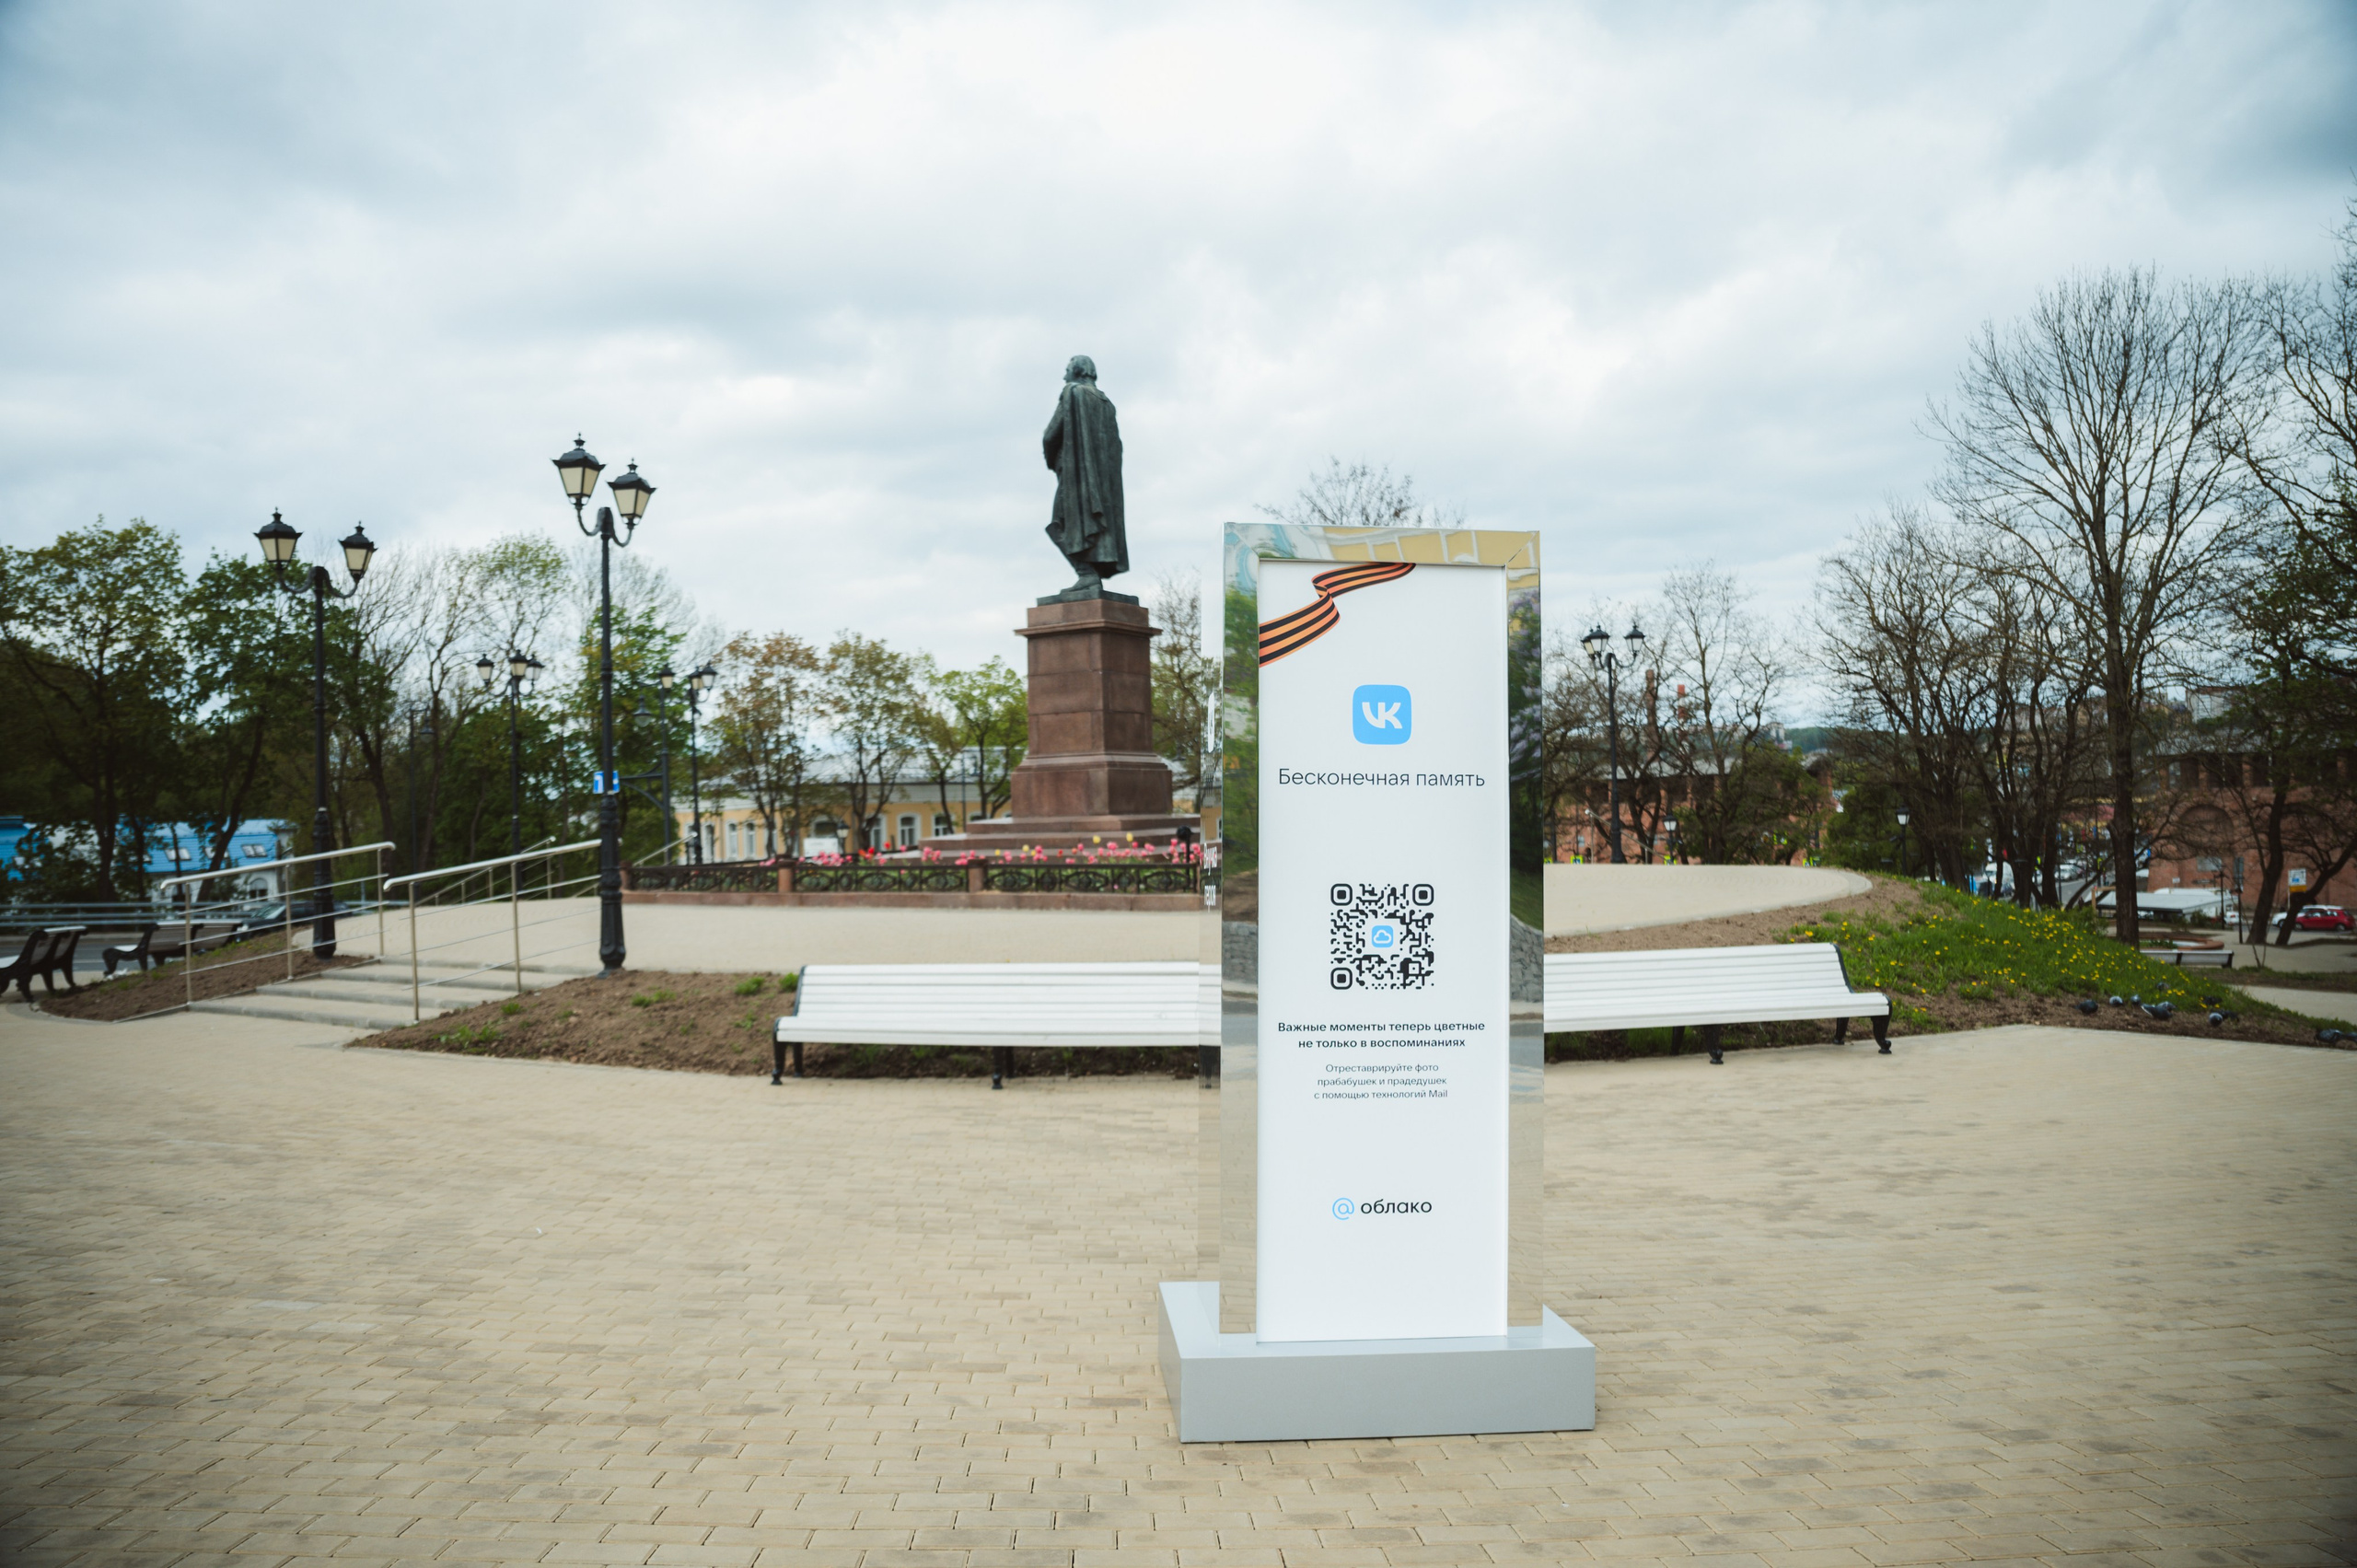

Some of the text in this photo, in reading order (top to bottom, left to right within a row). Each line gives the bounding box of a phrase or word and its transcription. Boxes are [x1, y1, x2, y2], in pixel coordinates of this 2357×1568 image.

[1362, 702, 1403, 729] VK
[1278, 768, 1486, 786] Бесконечная память
[1278, 1022, 1486, 1034] Важные моменты теперь цветные
[1298, 1040, 1466, 1049] не только в воспоминаниях
[1325, 1063, 1439, 1074] Отреставрируйте фото
[1317, 1077, 1447, 1088] прабабушек и прадедушек
[1321, 1092, 1370, 1100] помощью
[1371, 1089, 1427, 1099] технологий
[1428, 1089, 1448, 1098] Mail
[1360, 1198, 1433, 1214] облако
